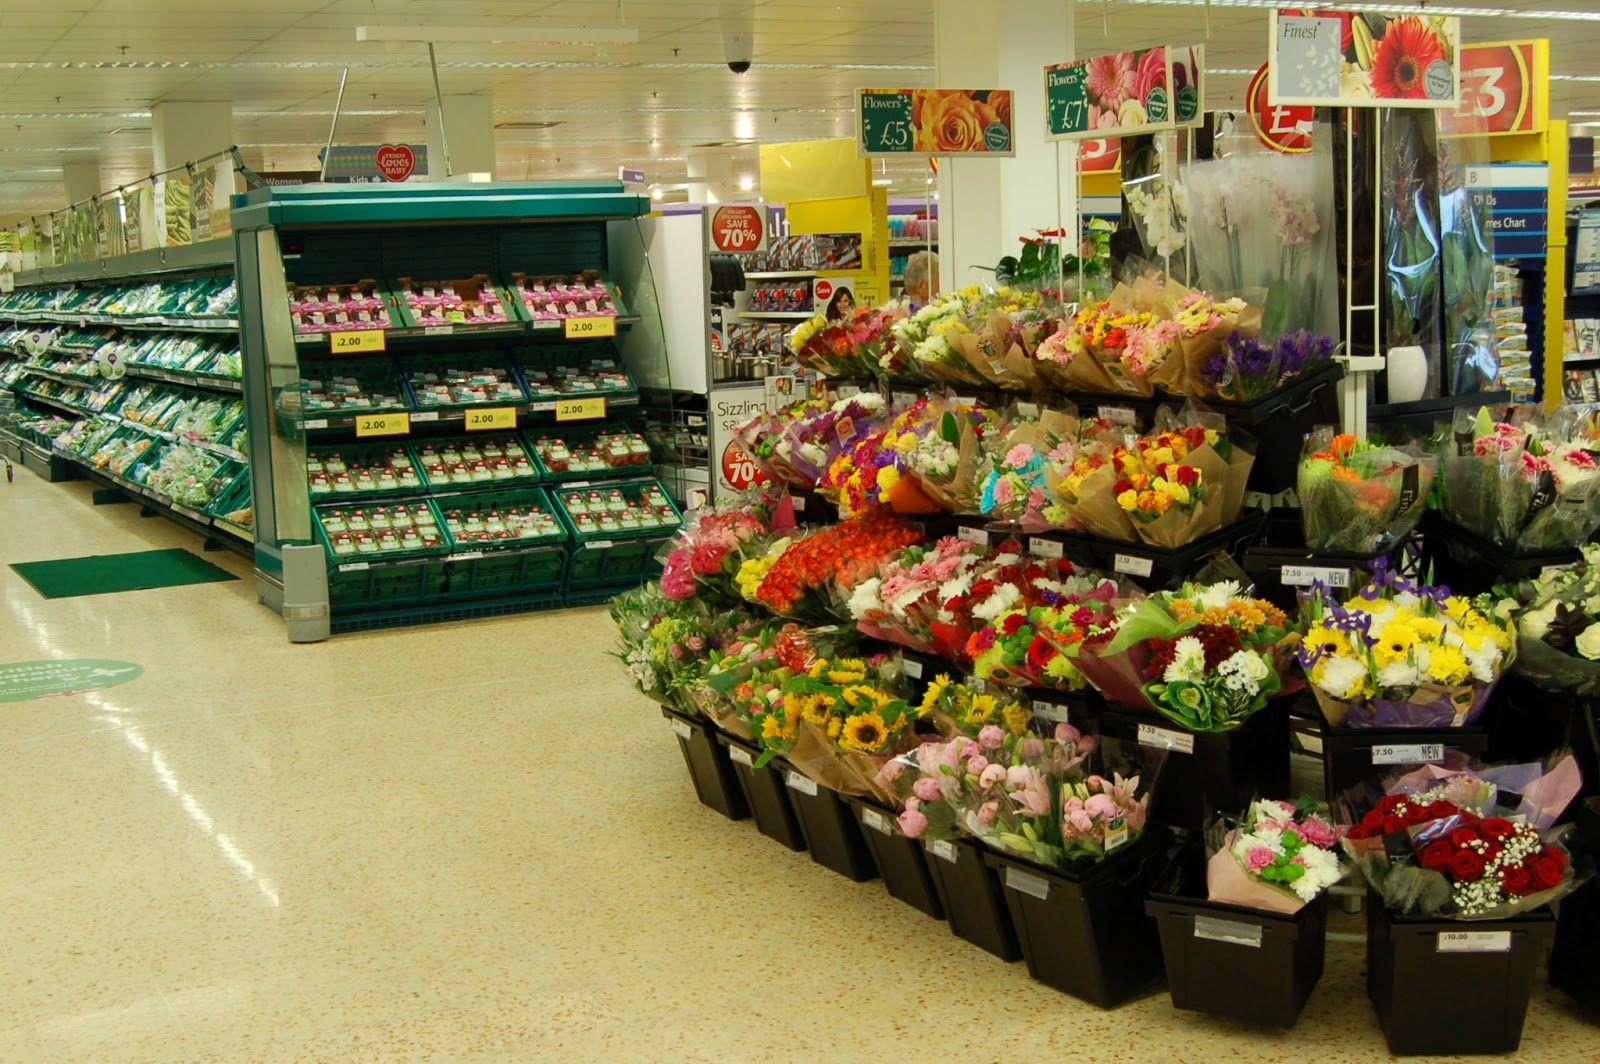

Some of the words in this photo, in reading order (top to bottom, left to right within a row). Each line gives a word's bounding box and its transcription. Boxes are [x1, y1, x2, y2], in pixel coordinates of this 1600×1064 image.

[1283, 22, 1318, 39] Finest
[1049, 74, 1078, 88] Flowers
[863, 96, 902, 109] Flowers
[1062, 100, 1083, 130] £7
[880, 121, 908, 146] £5
[379, 156, 410, 168] loves
[385, 167, 407, 175] BABY
[265, 177, 303, 186] Womens
[350, 175, 369, 184] Kids
[726, 219, 749, 229] SAVE
[1503, 217, 1526, 229] Chart
[720, 228, 757, 248] 70%
[1328, 571, 1346, 586] NEW
[1421, 745, 1440, 760] NEW
